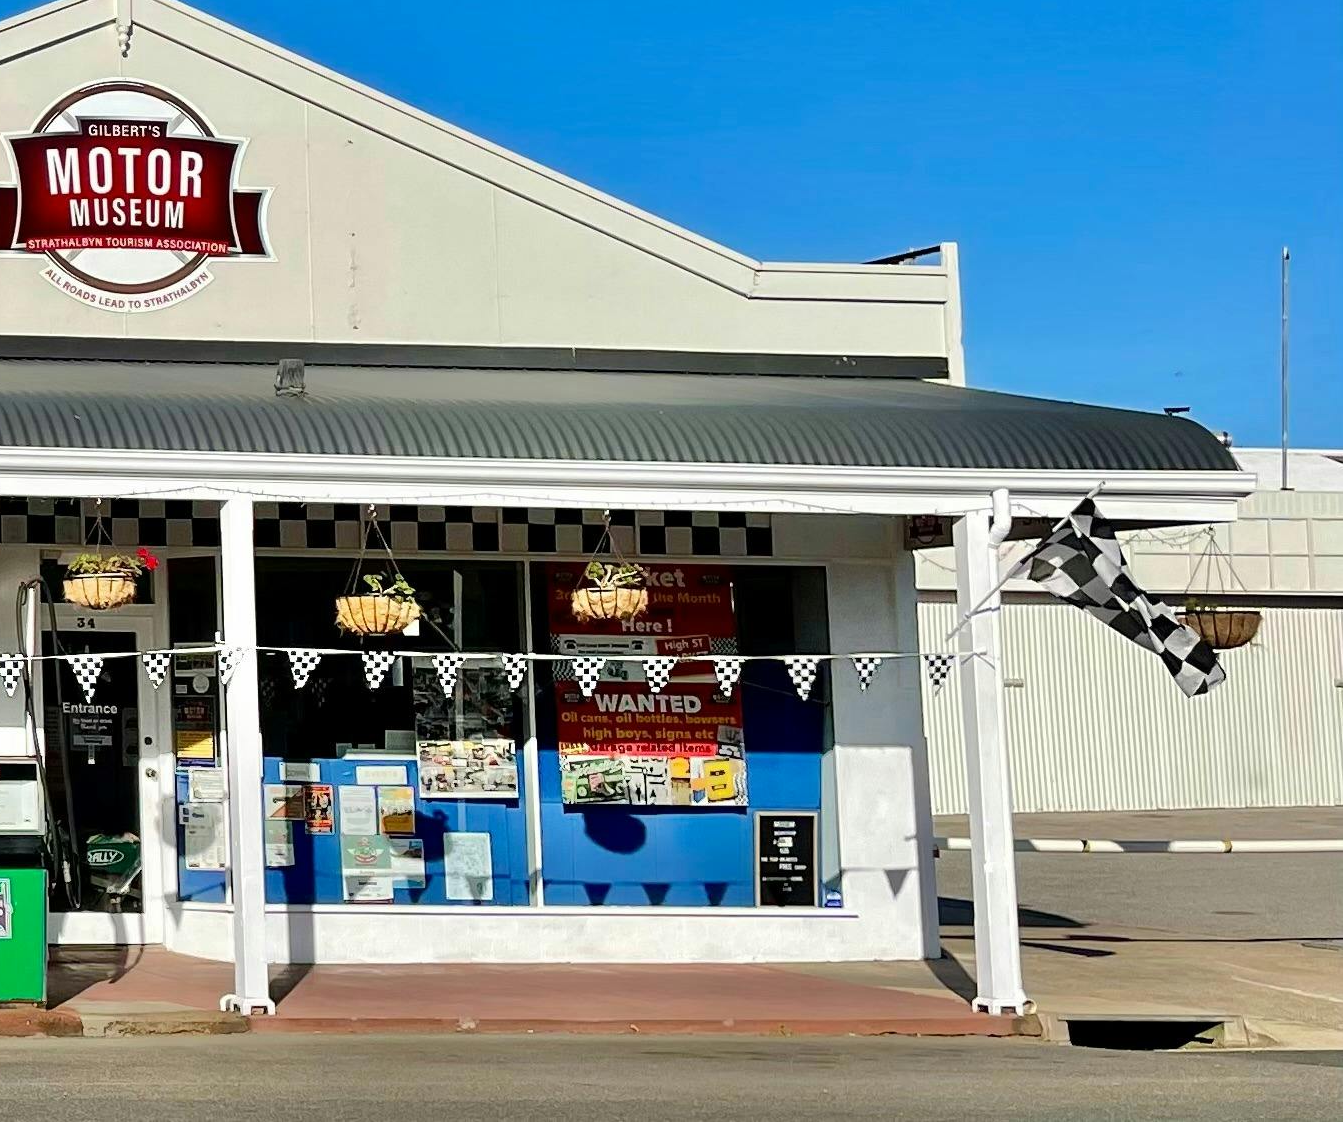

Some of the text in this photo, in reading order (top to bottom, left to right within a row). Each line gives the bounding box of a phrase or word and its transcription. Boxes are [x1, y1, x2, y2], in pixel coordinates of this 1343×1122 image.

[88, 124, 161, 138] GILBERT'S
[46, 146, 203, 198] MOTOR
[69, 197, 185, 229] MUSEUM
[27, 237, 227, 254] STRATHALBYN TOURISM ASSOCIATION
[45, 268, 209, 309] ALL ROADS LEAD TO STRATHALBYN
[678, 593, 721, 604] Month
[77, 618, 96, 628] 34
[621, 619, 663, 633] Here
[664, 637, 704, 652] High ST
[62, 701, 118, 714] Entrance
[594, 693, 702, 714] WANTED
[561, 713, 578, 725] Oil
[616, 712, 632, 725] oil
[583, 728, 612, 742] high
[695, 727, 714, 739] etc
